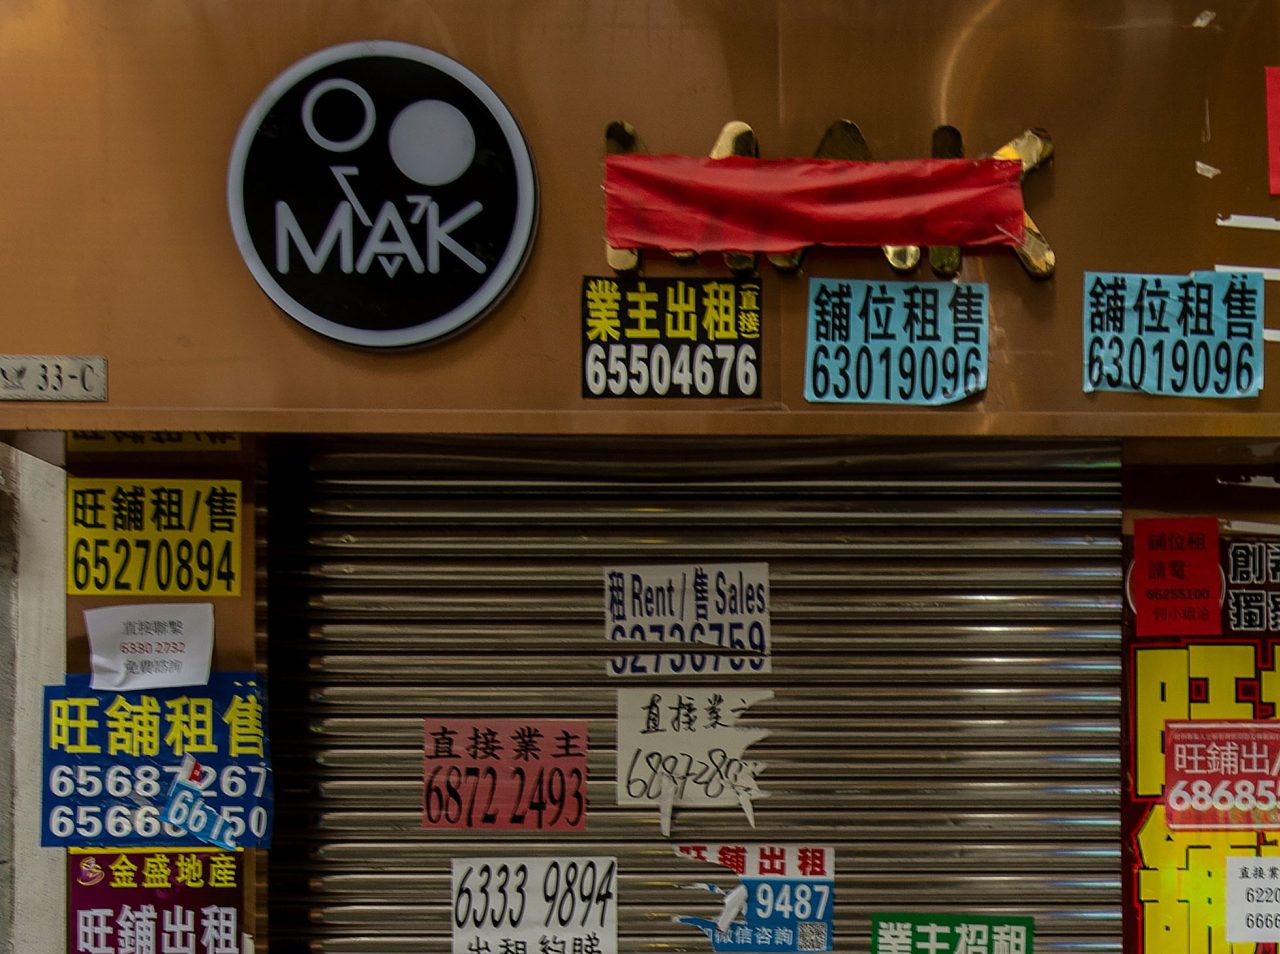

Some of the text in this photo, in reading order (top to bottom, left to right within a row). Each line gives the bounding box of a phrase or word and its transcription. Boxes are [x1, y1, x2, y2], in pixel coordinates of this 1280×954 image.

[275, 200, 486, 275] MAK
[586, 279, 738, 341] 業主出租
[37, 363, 95, 392] 33-C
[585, 344, 757, 396] 65504676
[812, 346, 982, 400] 63019096
[1088, 336, 1254, 392] 63019096
[73, 538, 236, 592] 65270894
[425, 725, 586, 761] 直接業主
[50, 806, 267, 838] 656650
[454, 863, 528, 929] 6333
[755, 882, 830, 920] 9487
